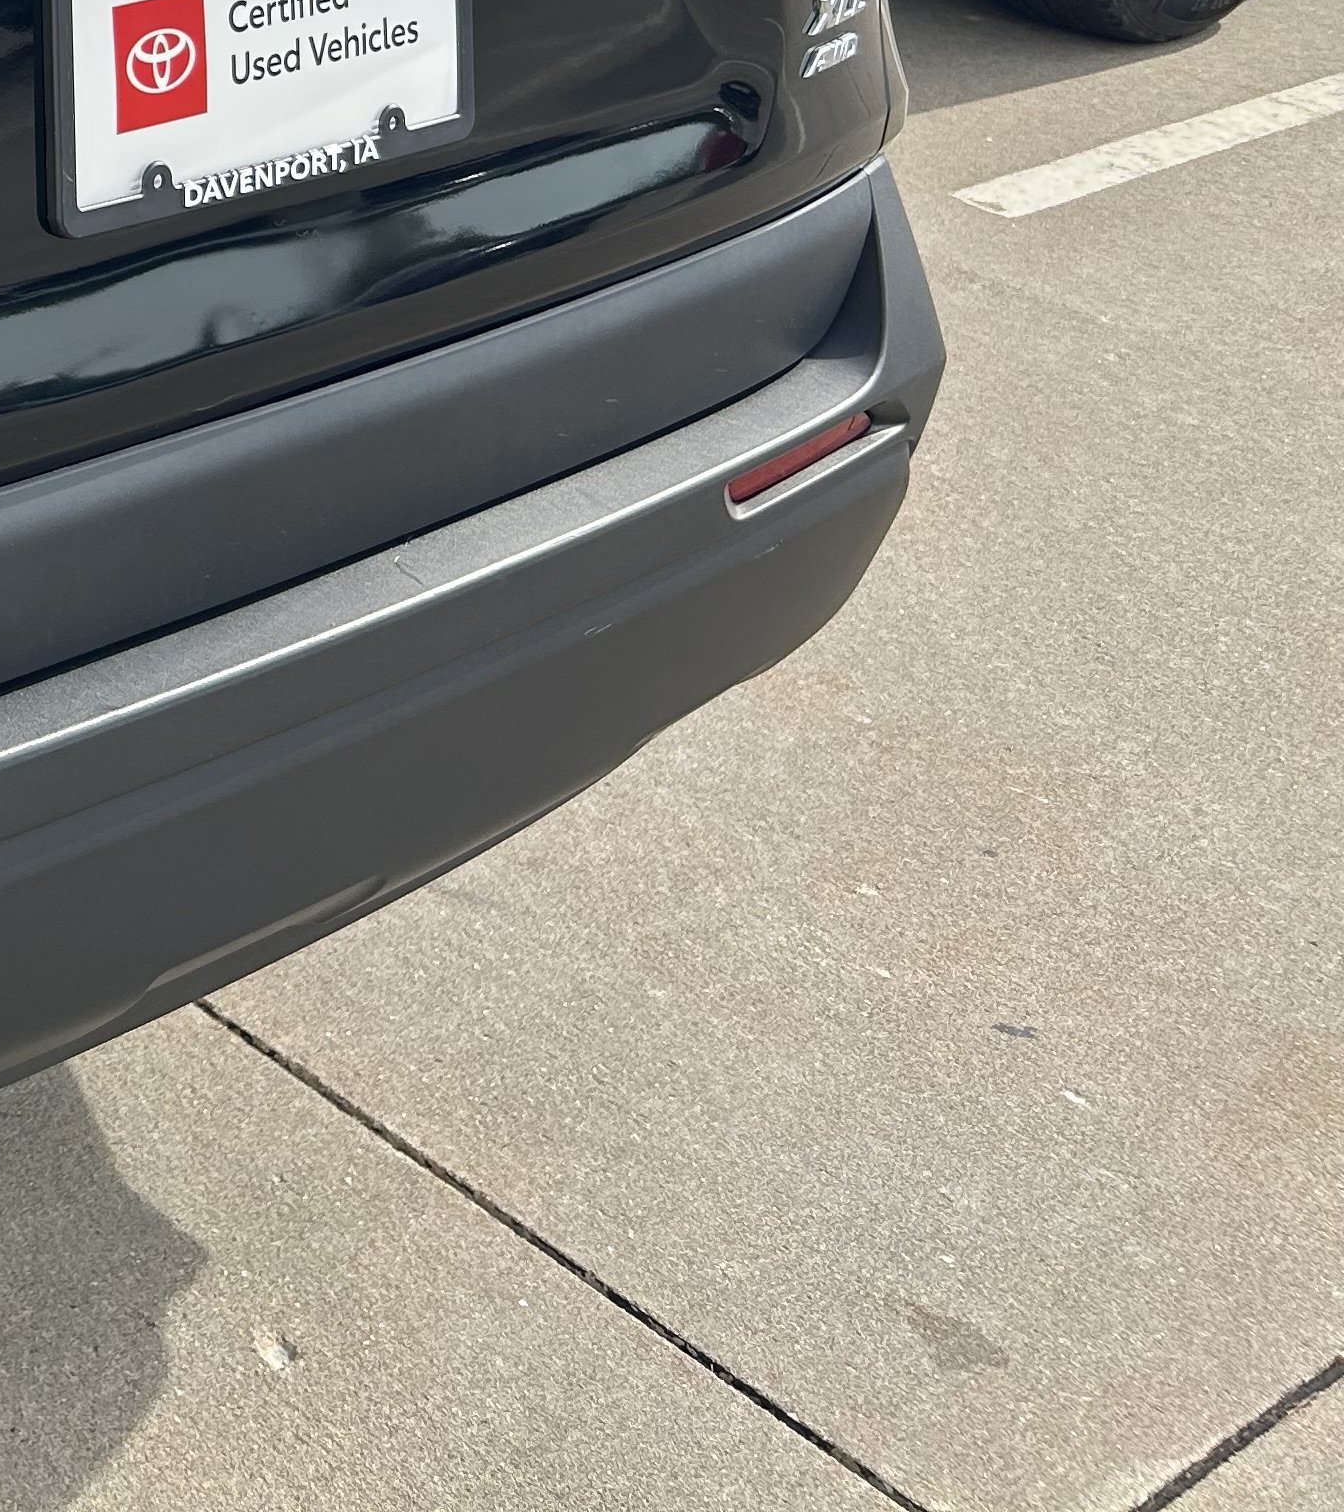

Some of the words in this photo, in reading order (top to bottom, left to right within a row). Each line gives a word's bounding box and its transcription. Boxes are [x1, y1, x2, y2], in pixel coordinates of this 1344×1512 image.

[231, 38, 302, 85] Used
[309, 17, 420, 65] Vehicles
[183, 144, 348, 209] DAVENPORT,
[353, 135, 380, 168] IA
